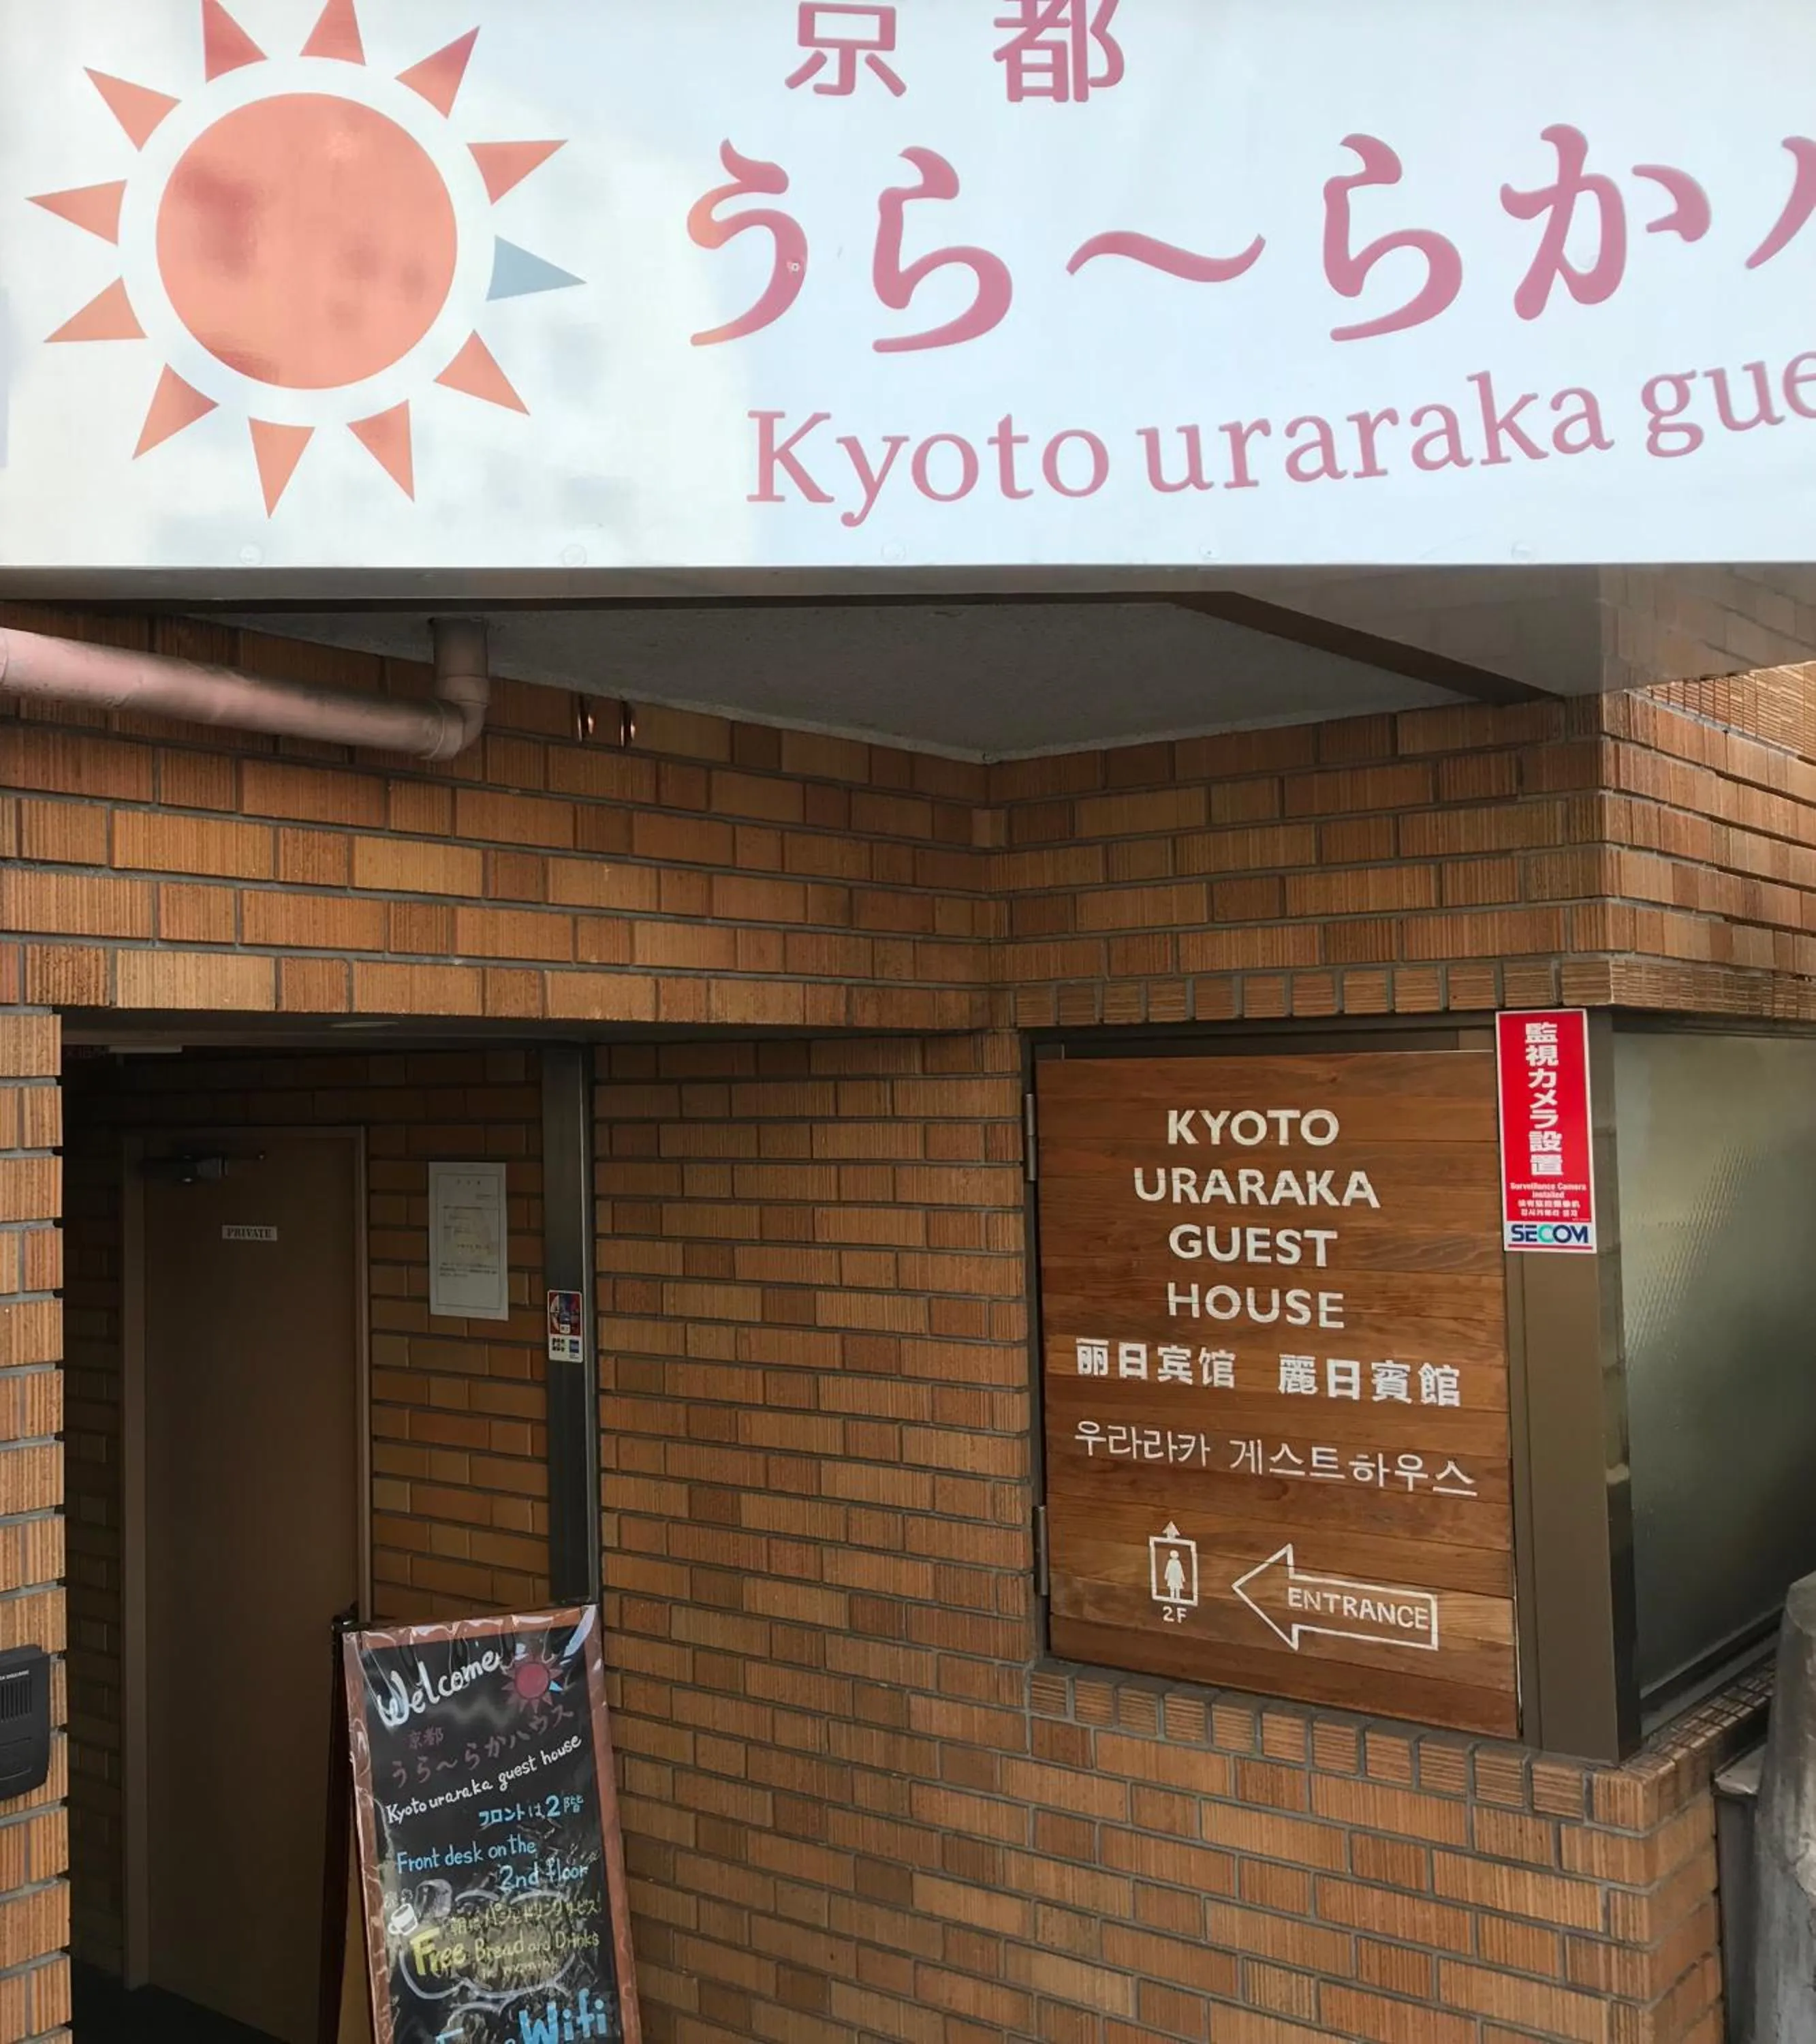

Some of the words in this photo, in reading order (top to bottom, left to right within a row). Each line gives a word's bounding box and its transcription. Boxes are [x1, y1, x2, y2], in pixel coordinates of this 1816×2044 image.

[747, 409, 1108, 527] Kyoto
[1136, 371, 1614, 493] uraraka
[1524, 1021, 1564, 1177] 監視カメラ設置
[1167, 1109, 1340, 1147] KYOTO
[1133, 1166, 1381, 1209] URARAKA
[227, 1227, 272, 1238] PRIVATE
[1168, 1223, 1338, 1267] GUEST
[1511, 1224, 1588, 1243] SECOM
[1167, 1282, 1345, 1329] HOUSE
[1076, 1337, 1236, 1390] 丽日宾馆
[1277, 1353, 1462, 1408] 麗日賓館
[1074, 1420, 1211, 1468] 우라라카
[1229, 1438, 1478, 1497] 게스트하우스
[1161, 1605, 1188, 1624] 2F
[1287, 1586, 1430, 1631] ENTRANCE
[376, 1649, 501, 1727] Welcome
[386, 1797, 428, 1825] Kyoto
[428, 1778, 494, 1808] uraraka
[497, 1754, 538, 1792] guest
[540, 1735, 582, 1765] house
[396, 1847, 441, 1874] Front
[444, 1840, 484, 1867] desk
[488, 1842, 507, 1859] on
[507, 1833, 537, 1855] the
[498, 1861, 541, 1893] 2nd
[545, 1855, 589, 1883] floor
[410, 1927, 467, 1977] Free
[475, 1929, 525, 1962] Bread
[528, 1932, 551, 1951] and
[555, 1929, 600, 1949] Drinks
[518, 1987, 608, 2044] Wifi
